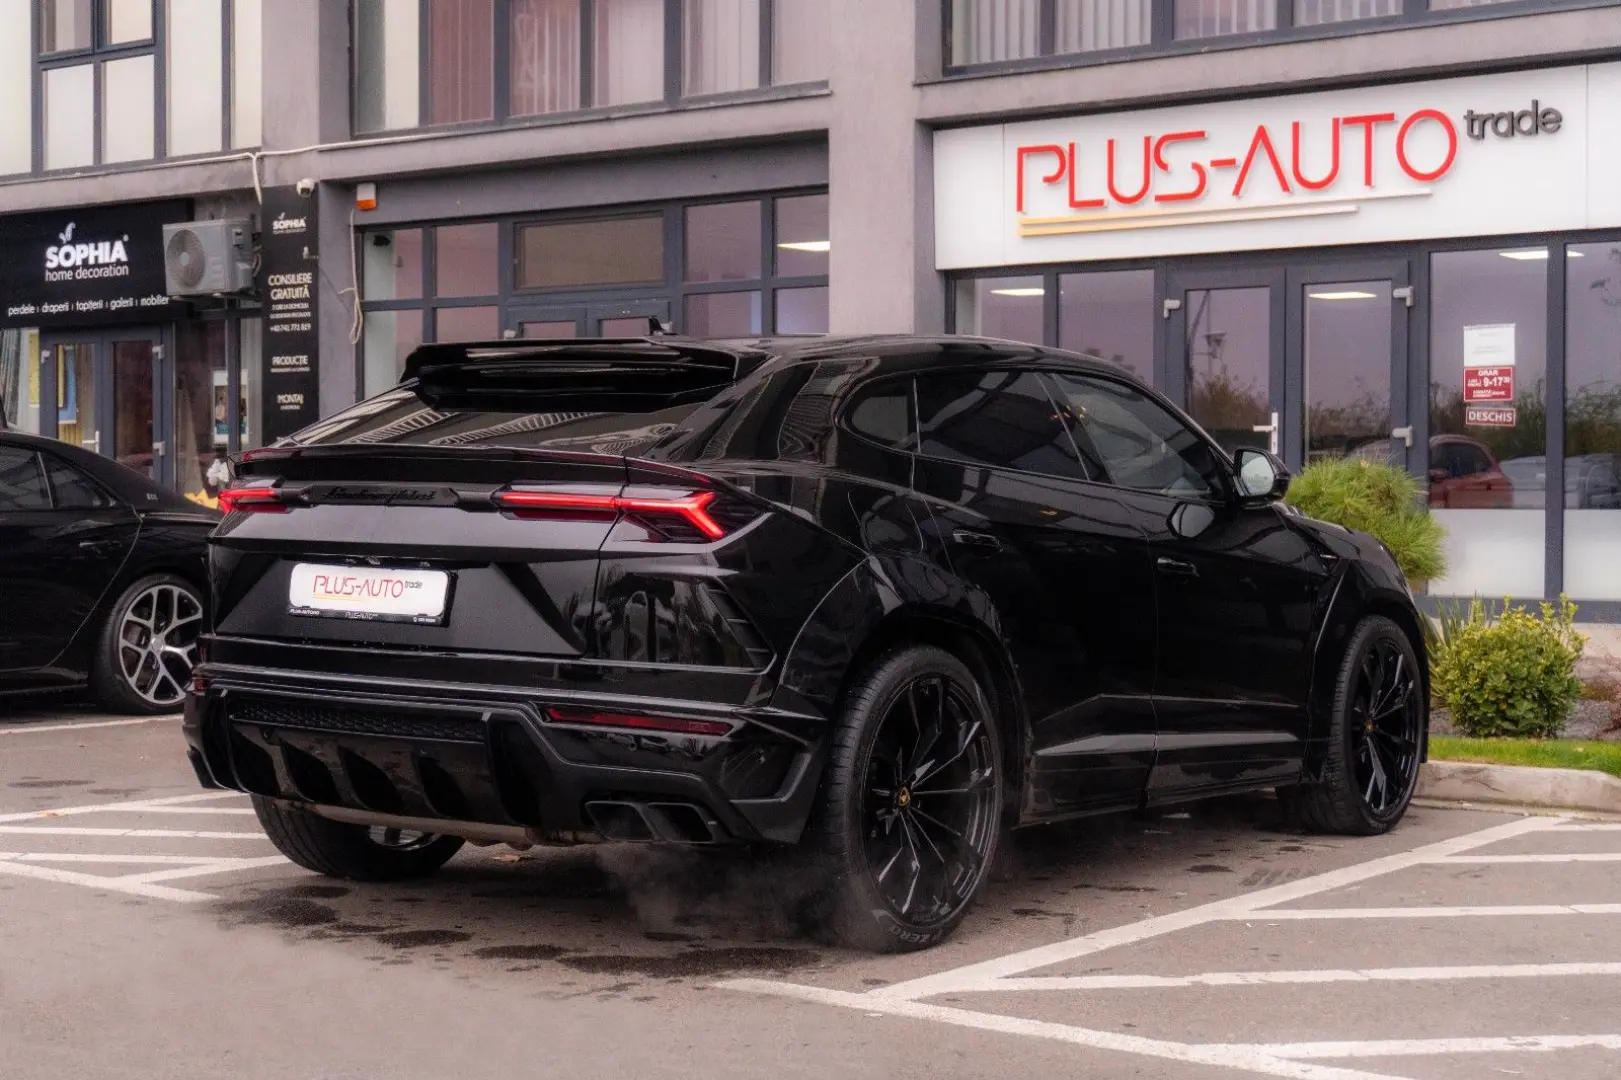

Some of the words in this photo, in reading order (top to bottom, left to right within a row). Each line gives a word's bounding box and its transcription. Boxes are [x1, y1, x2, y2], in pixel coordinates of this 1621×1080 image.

[1016, 108, 1458, 213] PLUS-AUTO
[1463, 100, 1562, 140] trade
[45, 240, 128, 268] SOPHIA
[45, 269, 73, 282] home
[75, 263, 129, 279] decoration
[268, 272, 312, 286] CONSILIERE
[8, 304, 35, 317] perdele
[41, 302, 69, 314] draperii
[1468, 411, 1513, 422] DESCHIS
[313, 576, 404, 598] PLUS-AUTO
[404, 579, 424, 590] trade
